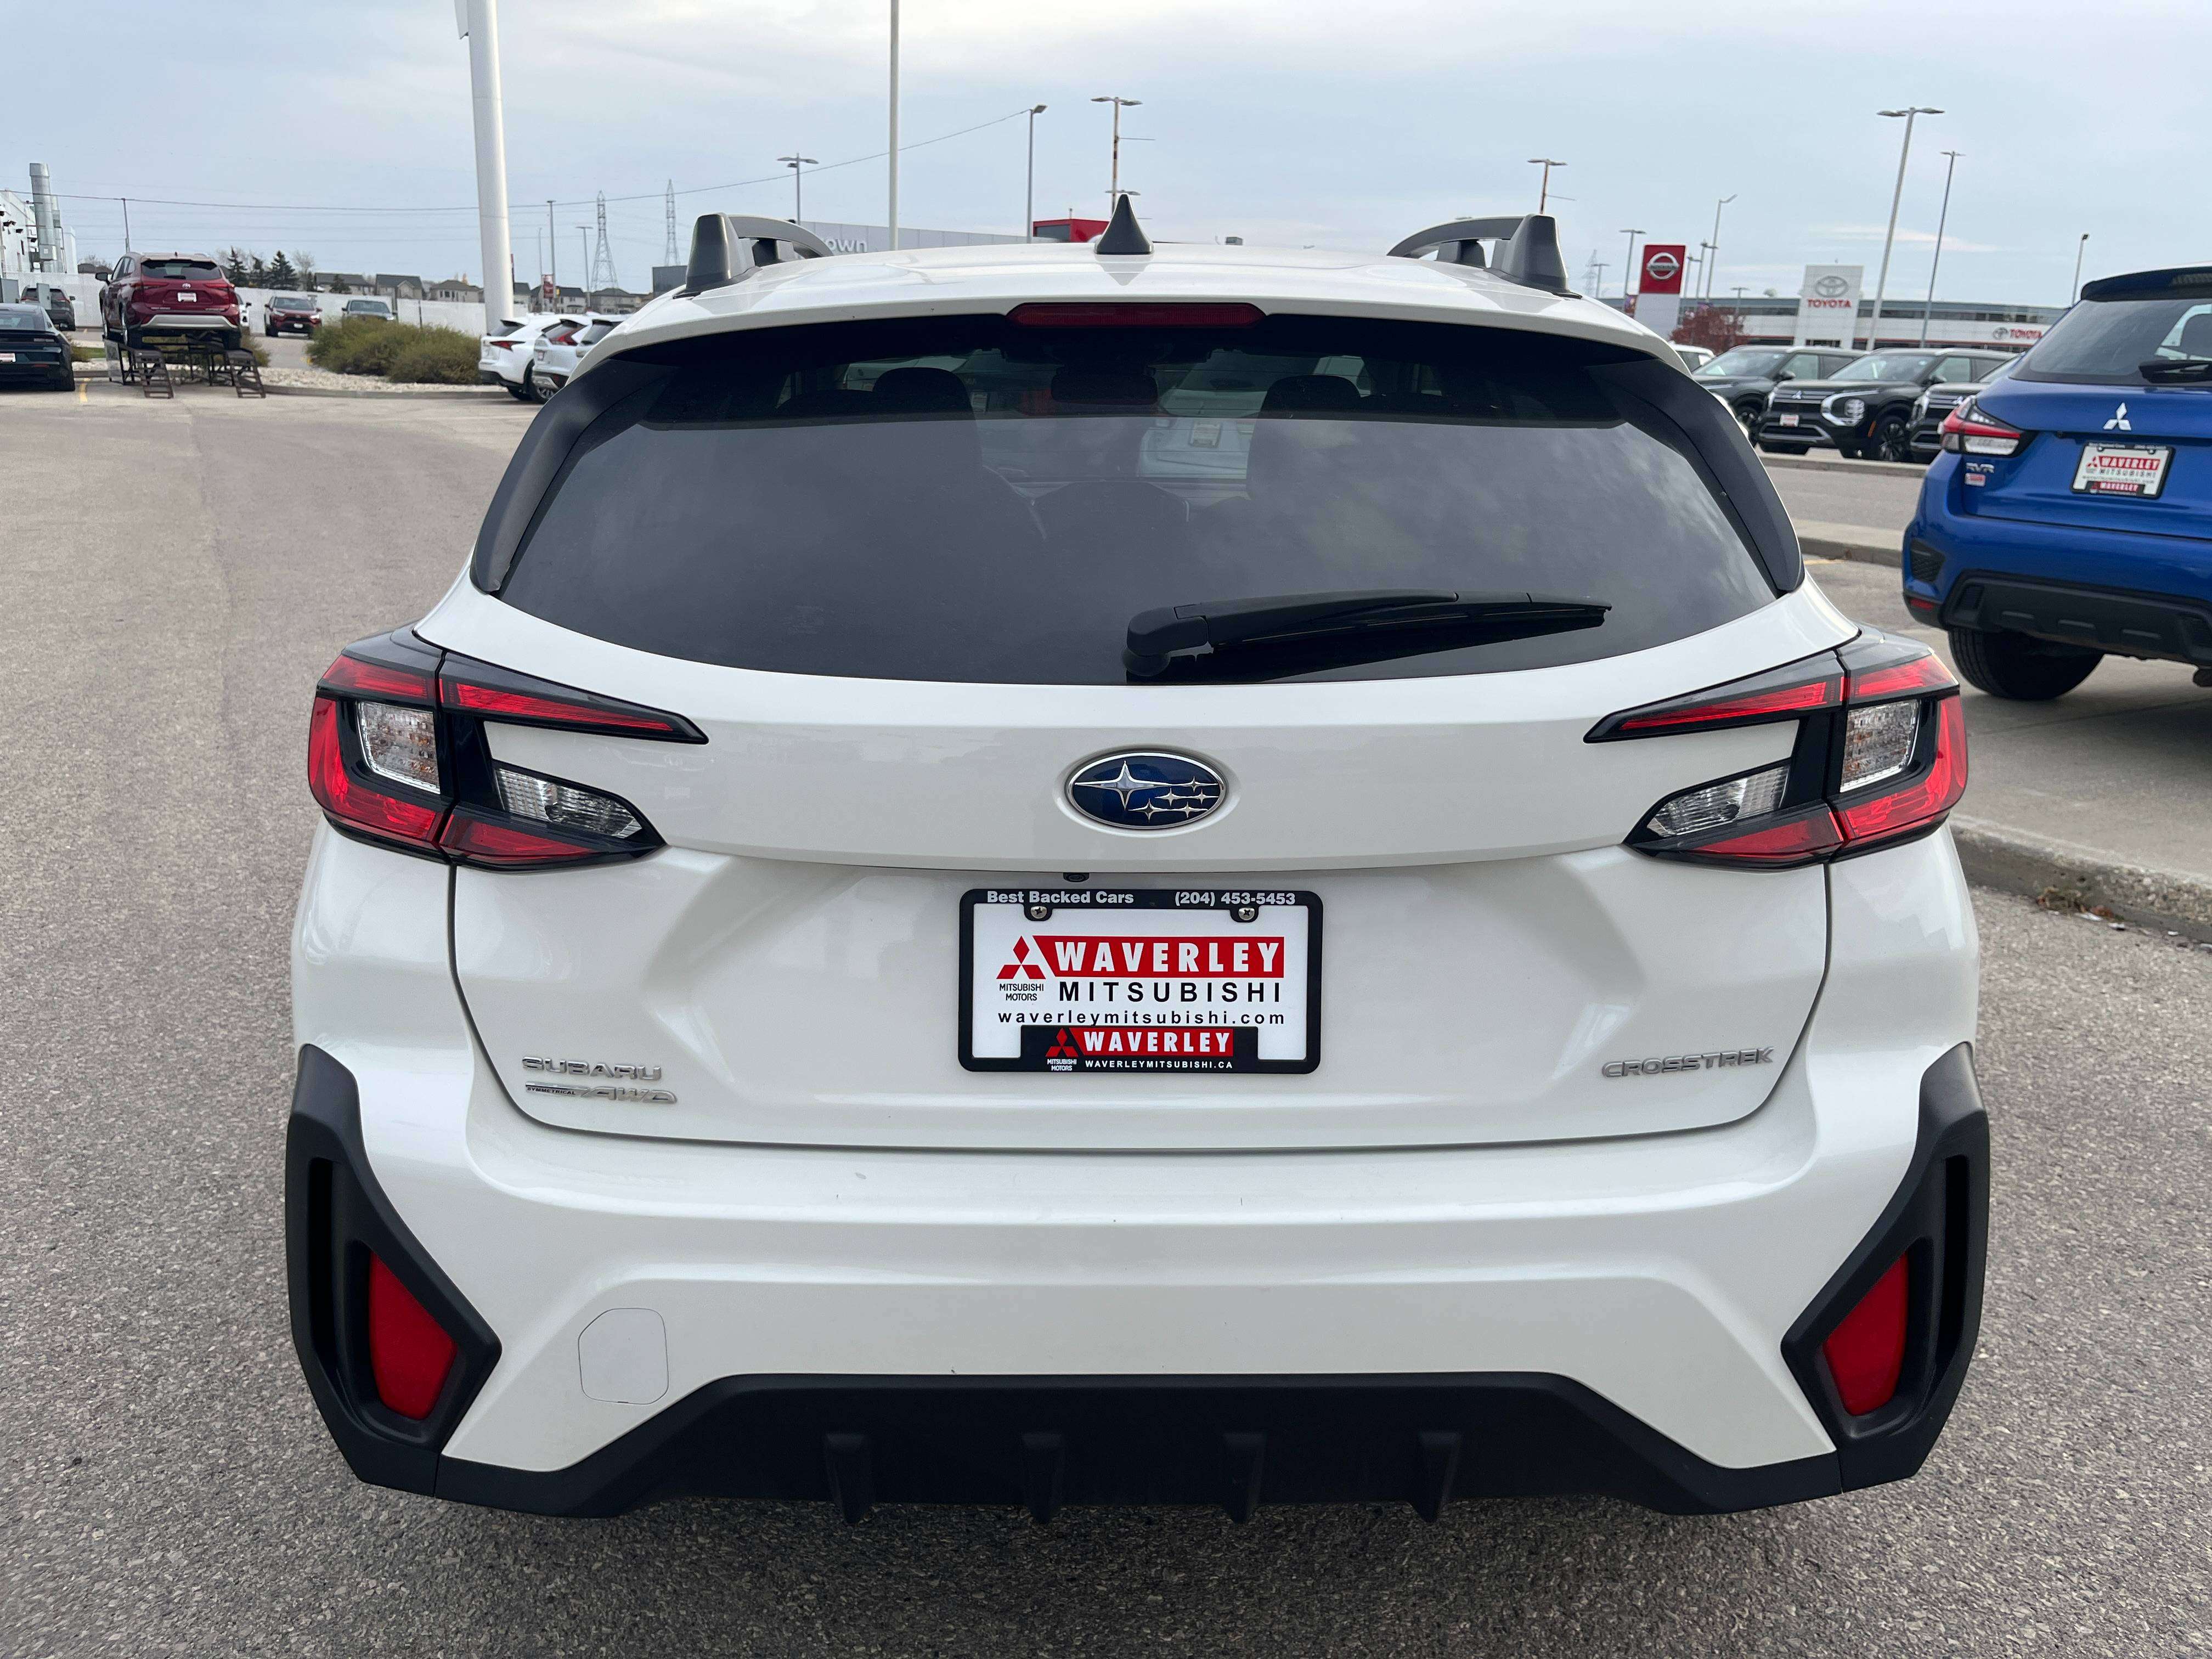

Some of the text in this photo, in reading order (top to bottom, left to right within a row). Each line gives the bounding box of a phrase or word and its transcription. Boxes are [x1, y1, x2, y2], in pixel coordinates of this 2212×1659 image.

[1808, 298, 1852, 308] TOYOTA
[2101, 456, 2160, 469] WAVERLEY
[988, 891, 1295, 906] Best Backed Cars (204) 453-5453
[1054, 941, 1279, 972] WAVERLEY
[999, 983, 1044, 991] MITSUBISHI
[1059, 981, 1280, 1002] MITSUBISHI
[998, 1010, 1284, 1026] waverleymitsubishi.com
[1084, 1031, 1230, 1052] WAVERLEY
[522, 1056, 662, 1081] SUBARU
[1085, 1060, 1233, 1069] WAVERLEYMITSUBISHI.CA
[1602, 1046, 1775, 1077] CROSSTREK
[527, 1086, 678, 1104] SYMMETRICAL AWD
